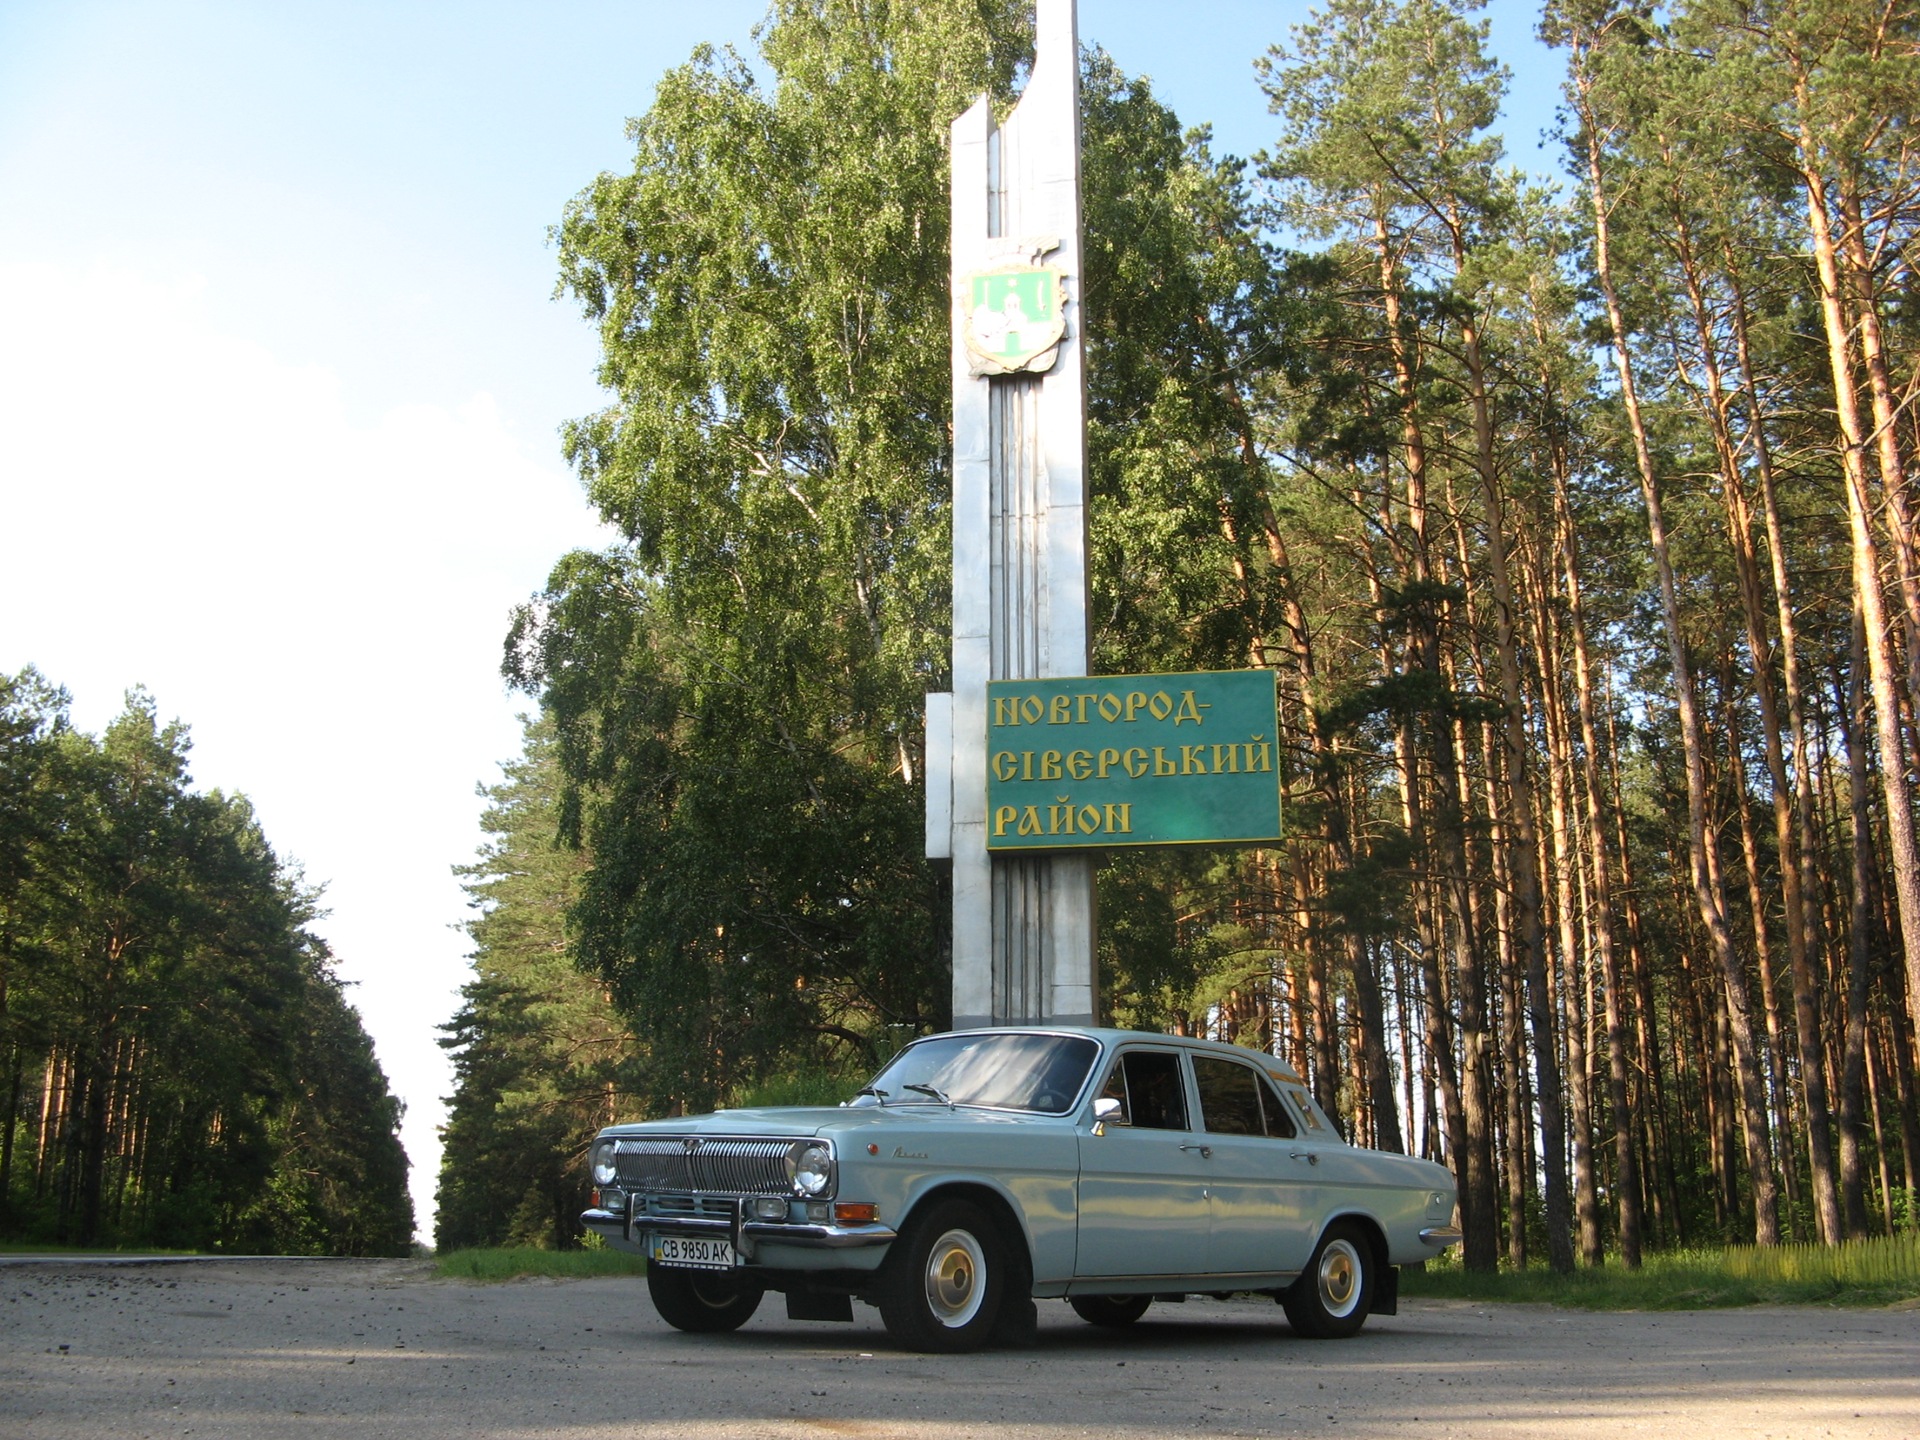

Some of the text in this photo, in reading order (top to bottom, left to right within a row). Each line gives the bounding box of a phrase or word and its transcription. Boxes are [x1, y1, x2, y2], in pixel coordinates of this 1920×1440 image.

[992, 690, 1211, 726] НОВГОРОД-
[992, 795, 1132, 836] РАЙОН
[662, 1240, 730, 1262] CB 9850 AK
